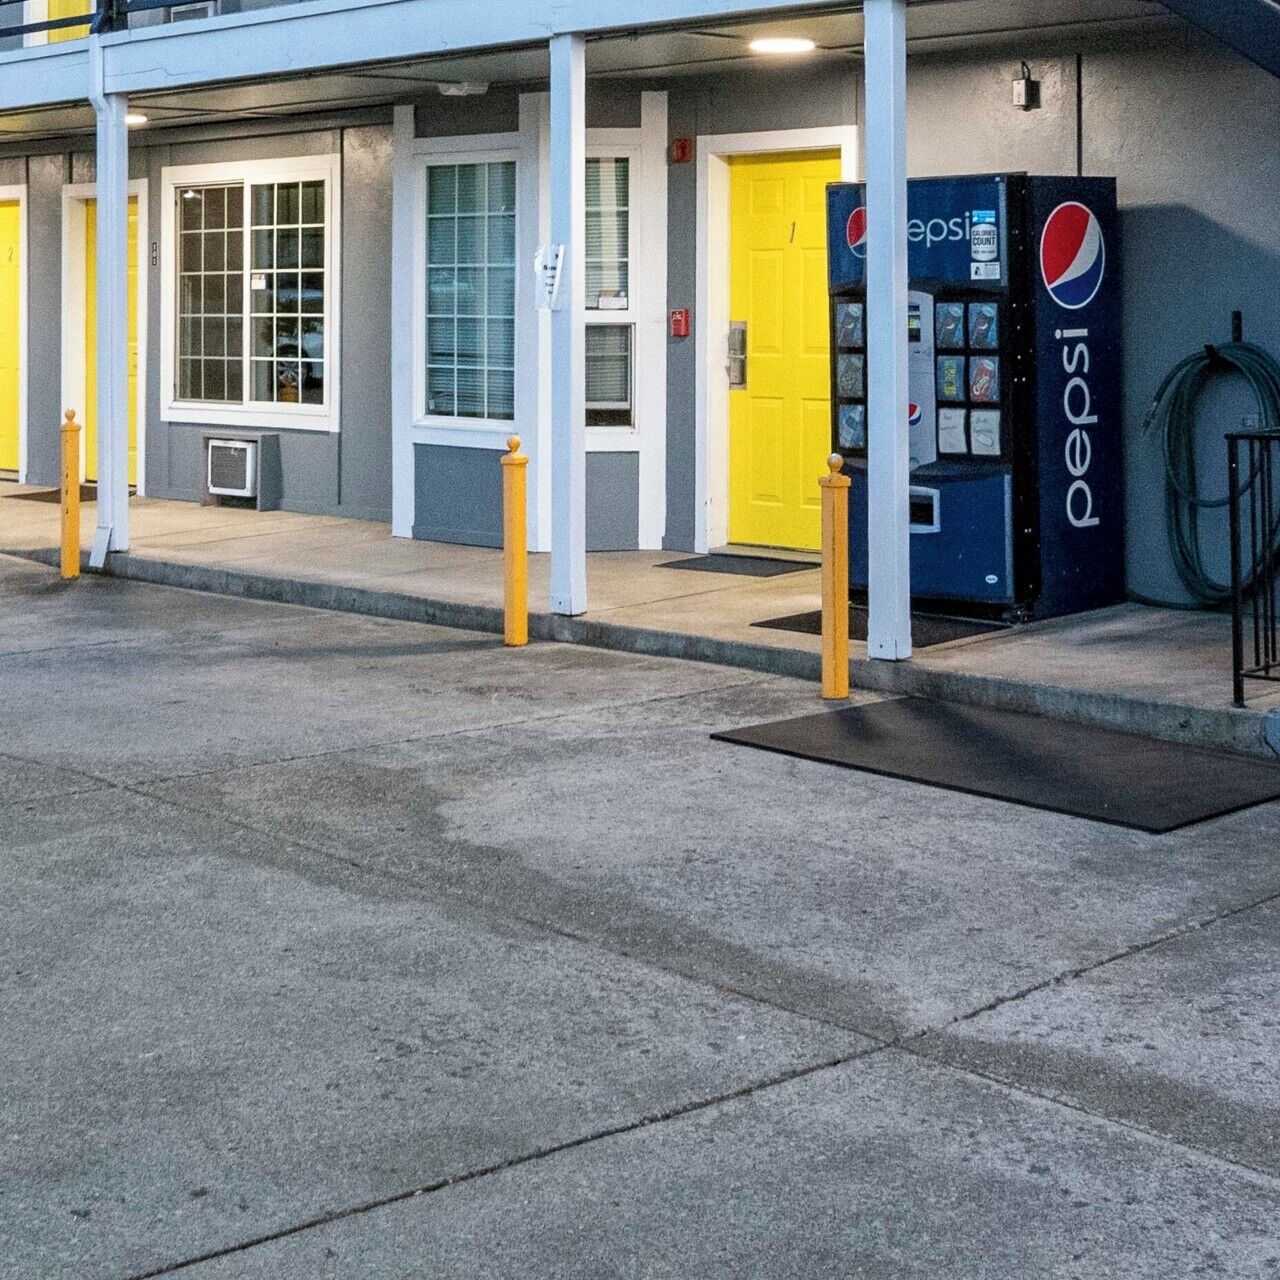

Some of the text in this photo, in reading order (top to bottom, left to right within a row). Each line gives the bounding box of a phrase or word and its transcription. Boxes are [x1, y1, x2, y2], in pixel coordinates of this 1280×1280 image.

[907, 211, 970, 248] epsi
[972, 236, 996, 246] COUNT
[1054, 328, 1100, 528] pepsi
